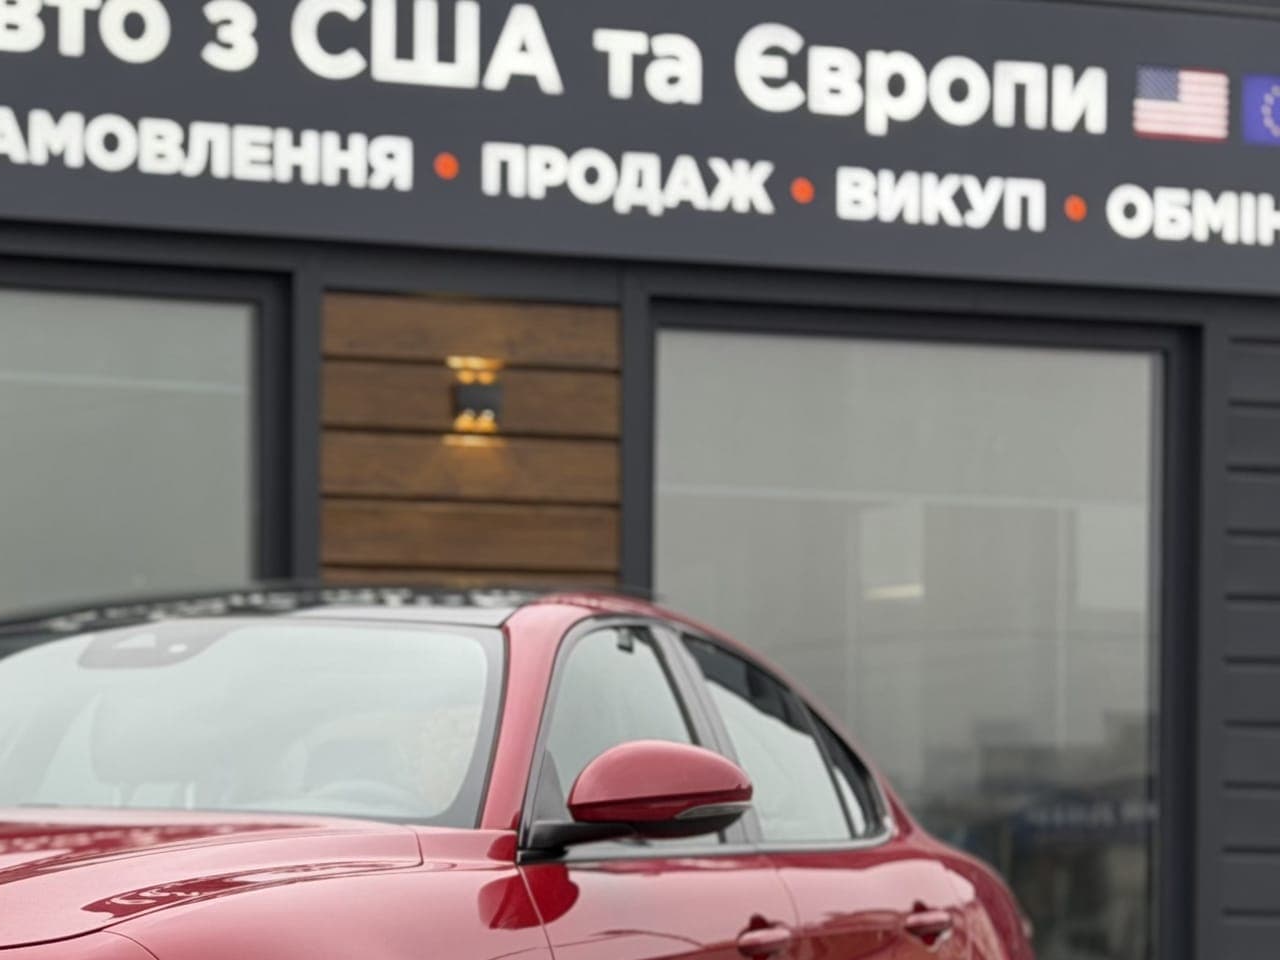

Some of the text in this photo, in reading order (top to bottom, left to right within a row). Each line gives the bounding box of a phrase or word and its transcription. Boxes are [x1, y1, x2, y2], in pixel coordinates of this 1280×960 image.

[200, 0, 259, 72] з
[290, 0, 564, 95] США
[592, 28, 703, 105] та
[734, 23, 1108, 137] Європи
[481, 141, 775, 217] ПРОДАЖ
[835, 166, 1047, 233] ВИКУП
